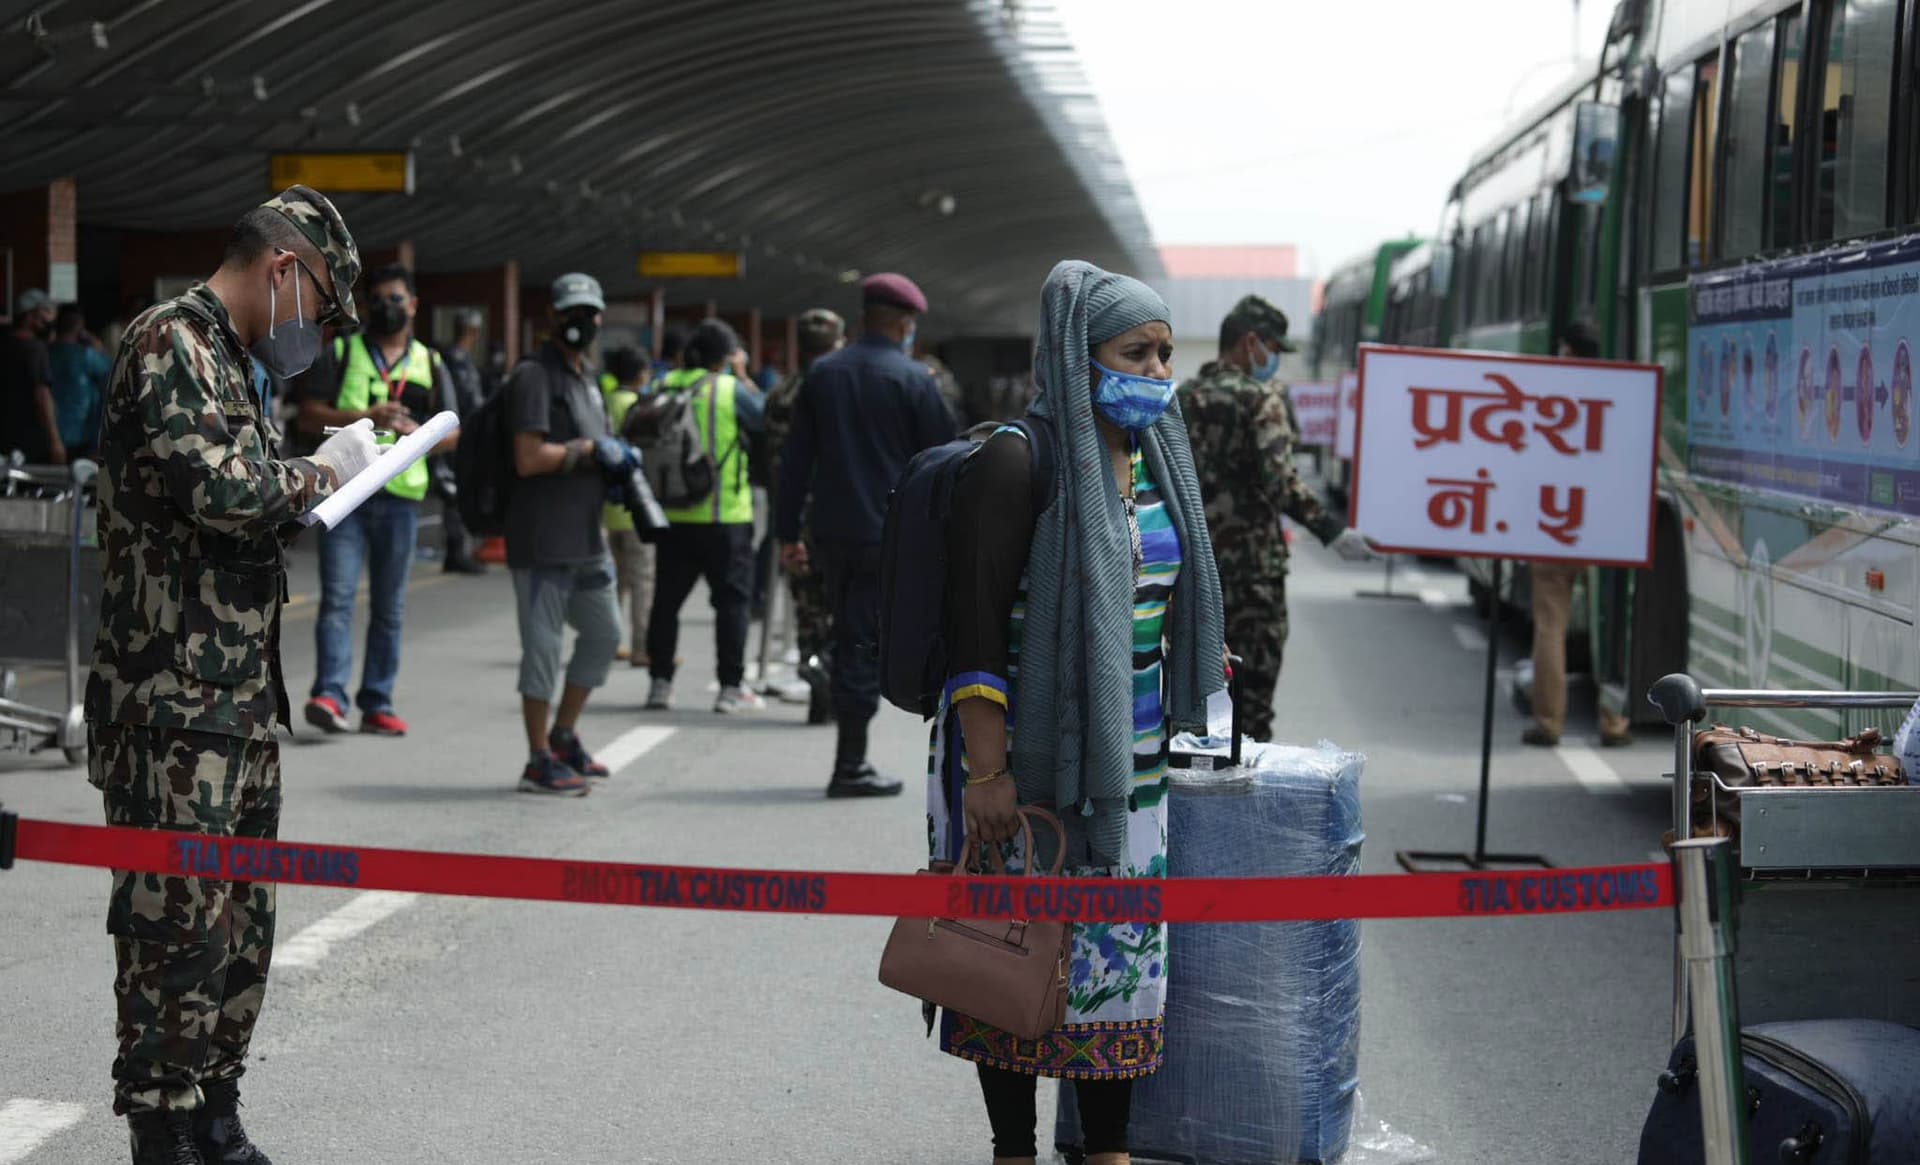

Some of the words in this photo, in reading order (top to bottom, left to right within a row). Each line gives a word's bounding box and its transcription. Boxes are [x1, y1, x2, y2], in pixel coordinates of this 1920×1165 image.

[1407, 372, 1614, 455] प्रदेश
[1426, 467, 1509, 535] नं.
[177, 839, 221, 875] TIA
[229, 844, 360, 885] CUSTOMS
[637, 870, 682, 905] TIA
[690, 872, 828, 911] CUSTOMS
[966, 882, 1014, 916] TIA
[1023, 884, 1163, 919] CUSTOMS
[1461, 878, 1512, 912] TIA
[1519, 869, 1660, 911] CUSTOMS
